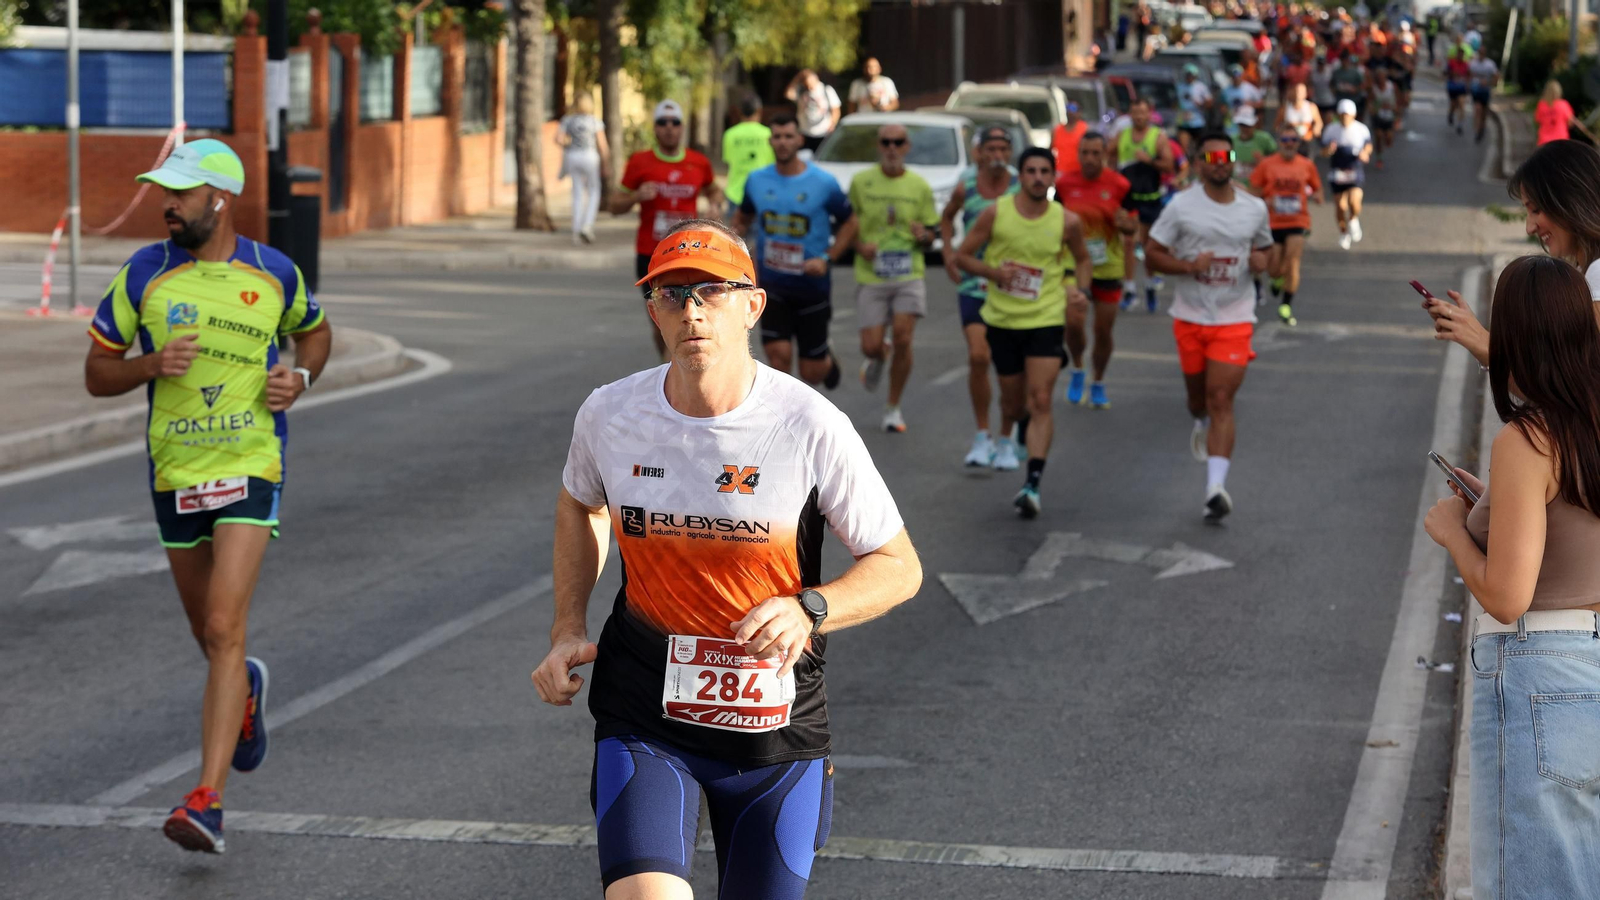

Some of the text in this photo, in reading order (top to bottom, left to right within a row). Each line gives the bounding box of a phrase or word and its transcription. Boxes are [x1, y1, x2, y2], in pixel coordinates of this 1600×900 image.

[650, 512, 769, 534] RUBYSAN
[650, 527, 770, 544] industria agrícola automoción
[697, 670, 763, 703] 284
